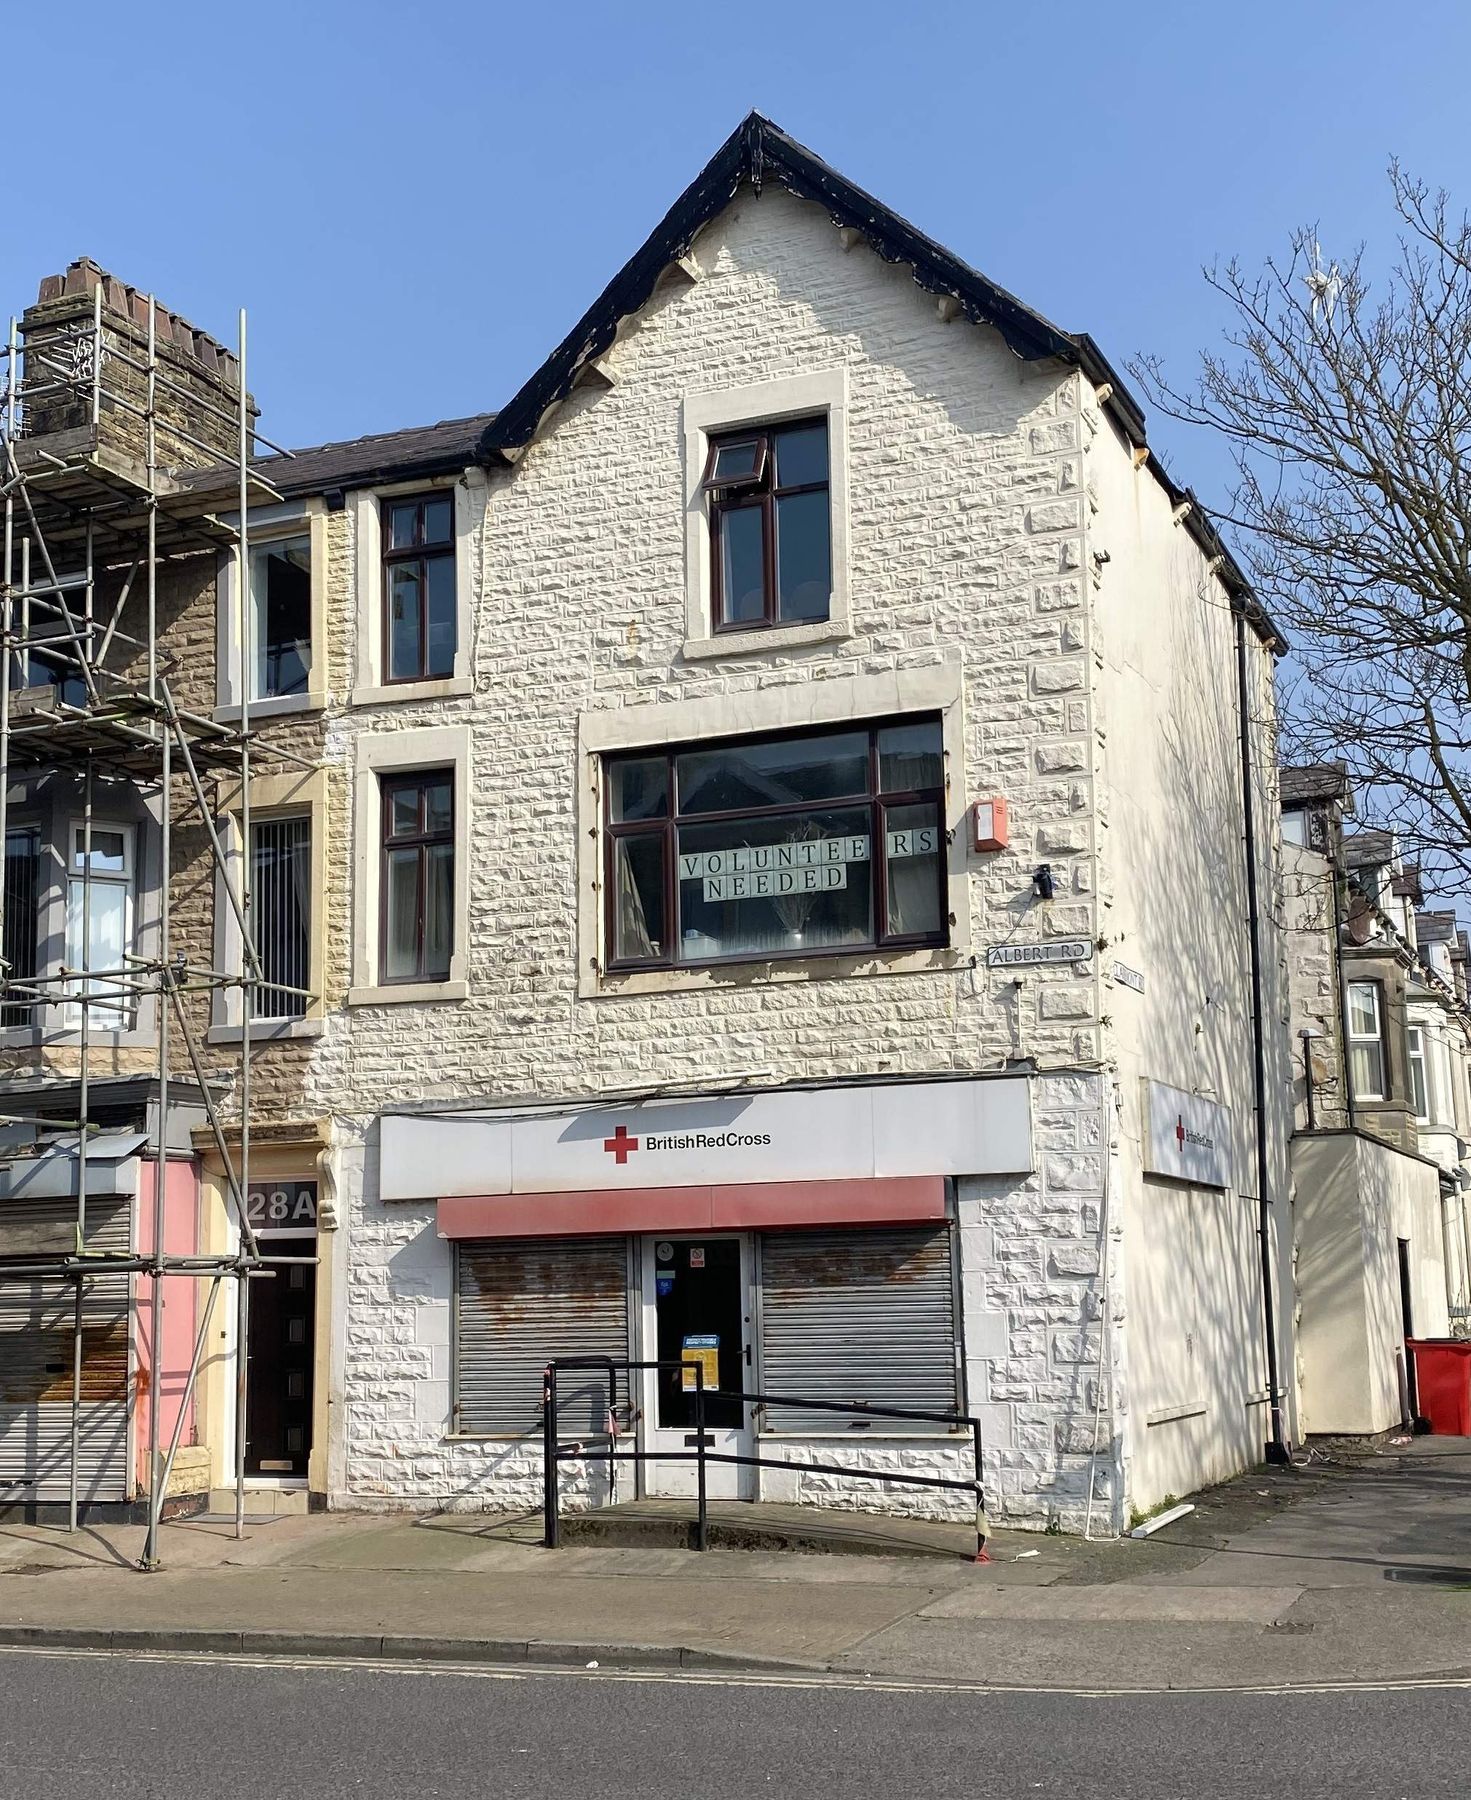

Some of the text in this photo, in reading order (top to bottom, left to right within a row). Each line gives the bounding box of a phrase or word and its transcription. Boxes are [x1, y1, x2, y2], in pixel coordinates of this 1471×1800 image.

[708, 867, 842, 898] NEEDED
[991, 943, 1085, 963] ALBERT RD
[646, 1132, 771, 1151] BritishRedCross
[249, 1190, 316, 1220] 28A
